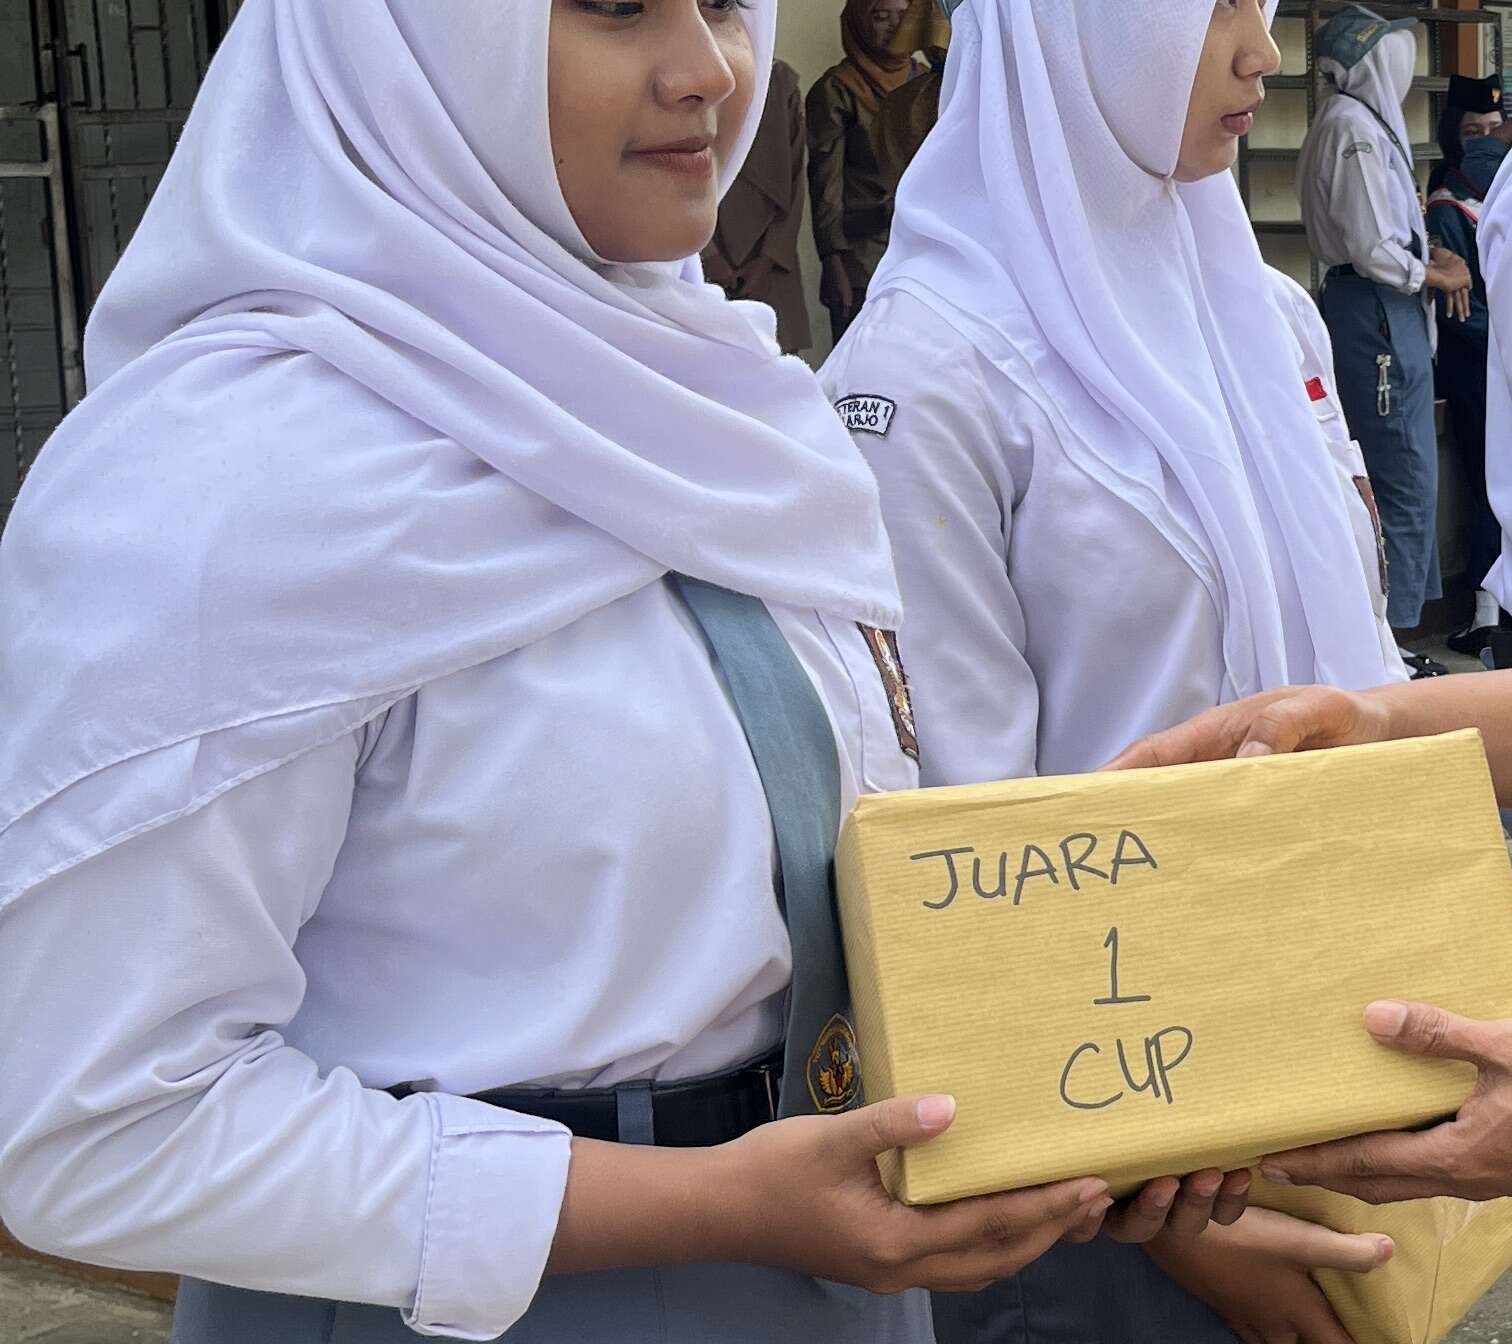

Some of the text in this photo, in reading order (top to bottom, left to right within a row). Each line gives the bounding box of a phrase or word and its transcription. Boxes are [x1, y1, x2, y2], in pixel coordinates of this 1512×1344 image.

[837, 400, 890, 418] TERAN 1
[842, 413, 879, 427] ARJO
[909, 829, 1159, 910] JUARA
[1092, 926, 1151, 1006] 1
[1059, 1024, 1194, 1110] CUP
